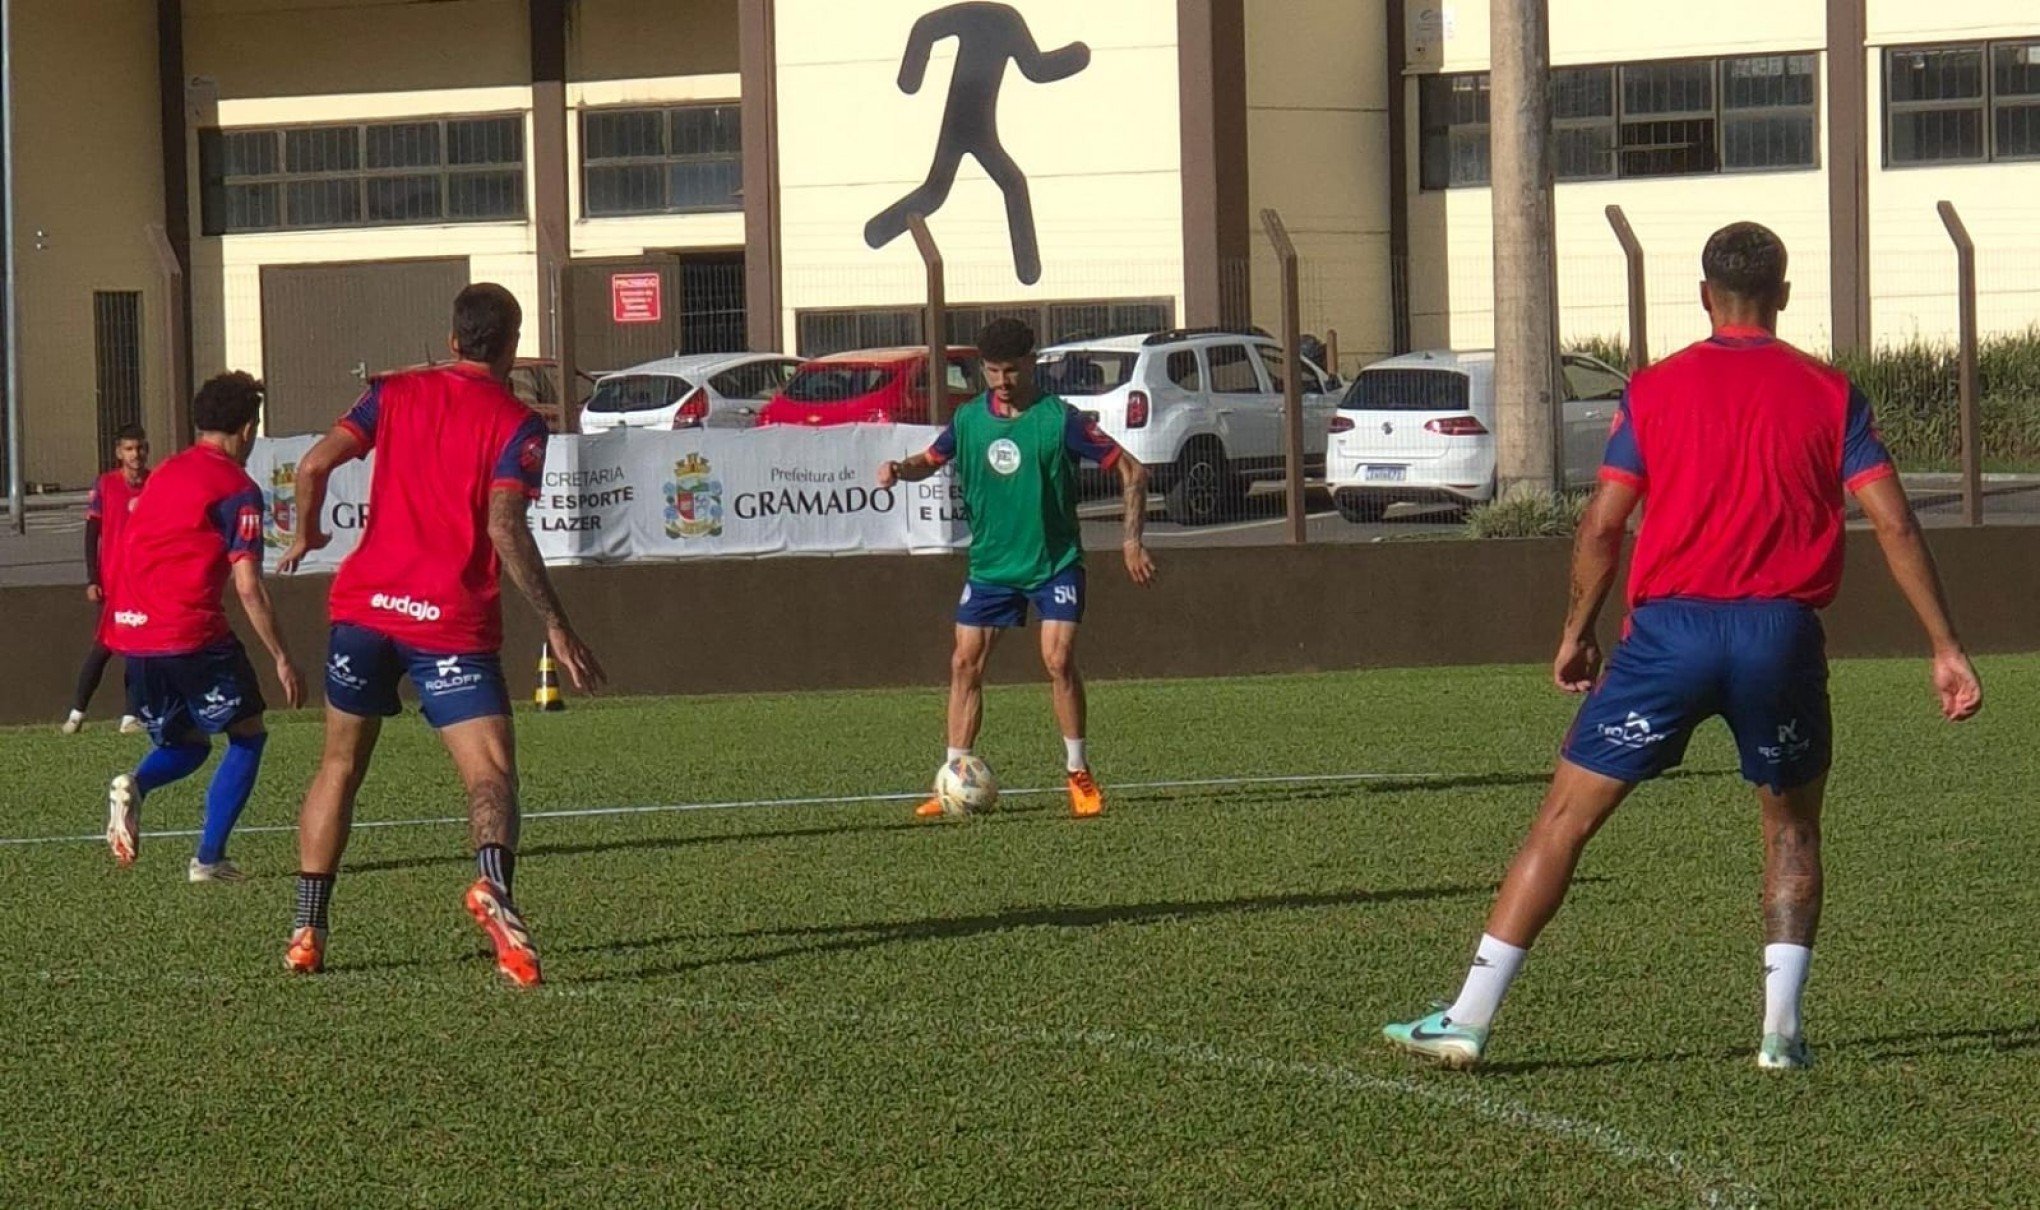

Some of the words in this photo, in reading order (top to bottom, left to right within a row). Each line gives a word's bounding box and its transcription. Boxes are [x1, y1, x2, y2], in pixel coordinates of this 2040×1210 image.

[771, 467, 834, 482] Prefeitura
[838, 465, 855, 480] de
[552, 486, 634, 509] ESPORTE
[919, 484, 943, 499] DE
[734, 486, 895, 520] GRAMADO
[921, 506, 932, 520] E
[541, 515, 602, 532] LAZER
[371, 593, 440, 621] eudajo
[425, 674, 481, 691] ROLOFF
